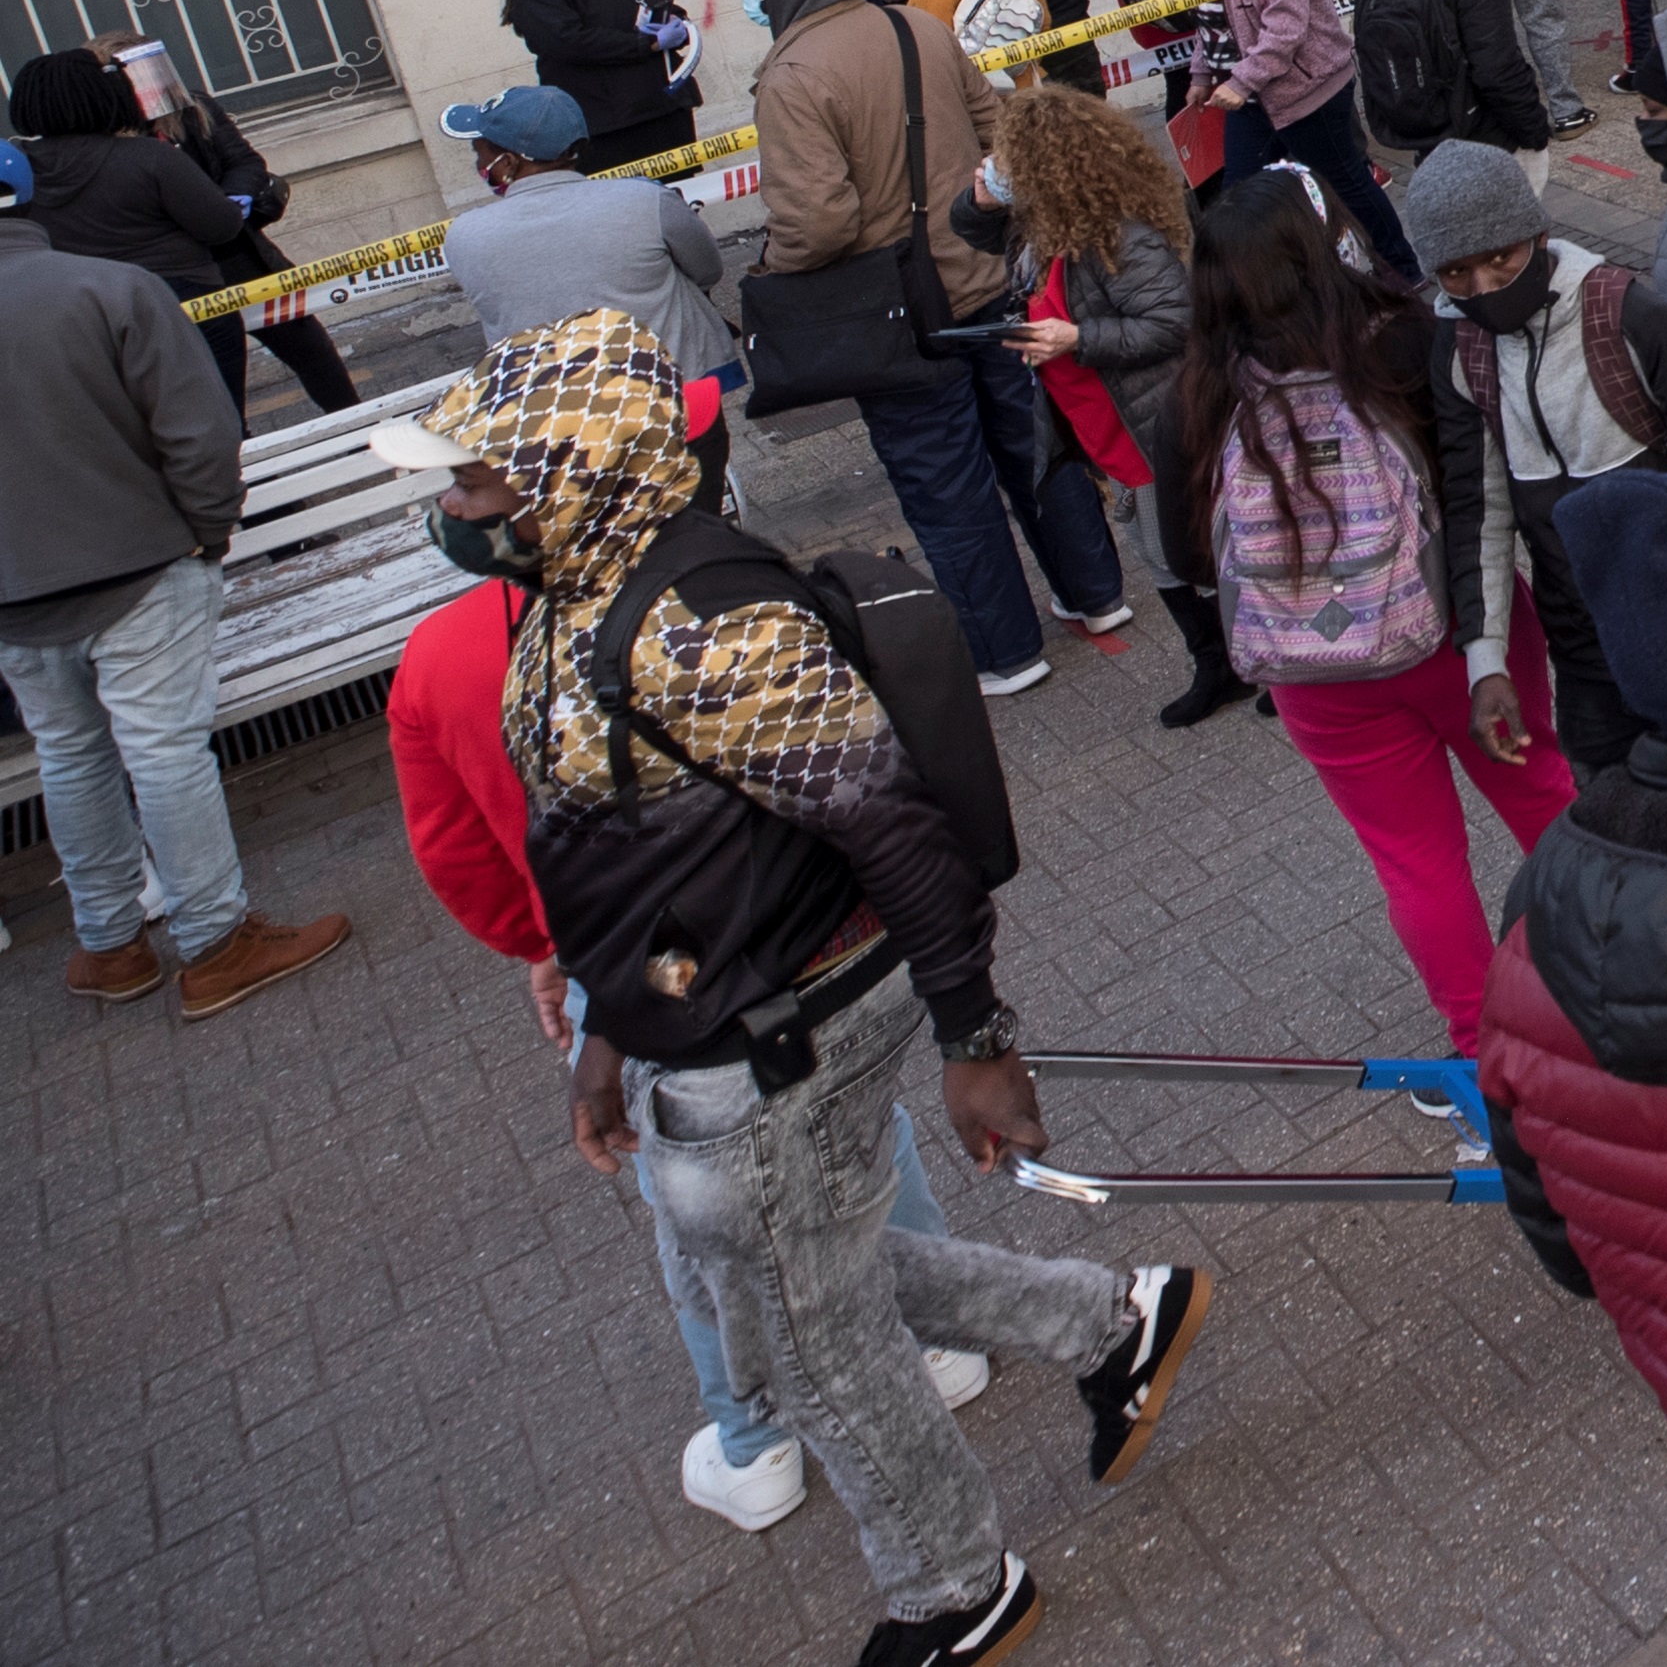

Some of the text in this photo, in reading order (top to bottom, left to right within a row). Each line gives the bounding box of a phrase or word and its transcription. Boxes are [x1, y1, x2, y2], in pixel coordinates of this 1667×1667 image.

[1003, 44, 1022, 65] NO
[1023, 32, 1065, 59] PASAR
[1084, 2, 1162, 38] CARABINEROS
[1155, 40, 1196, 65] PELI
[681, 145, 701, 167] DE
[703, 132, 742, 160] CHILE
[190, 286, 250, 321] PASAR
[278, 242, 390, 294] CARABINEROS
[392, 230, 417, 257] DE
[347, 246, 445, 285] PELIGR
